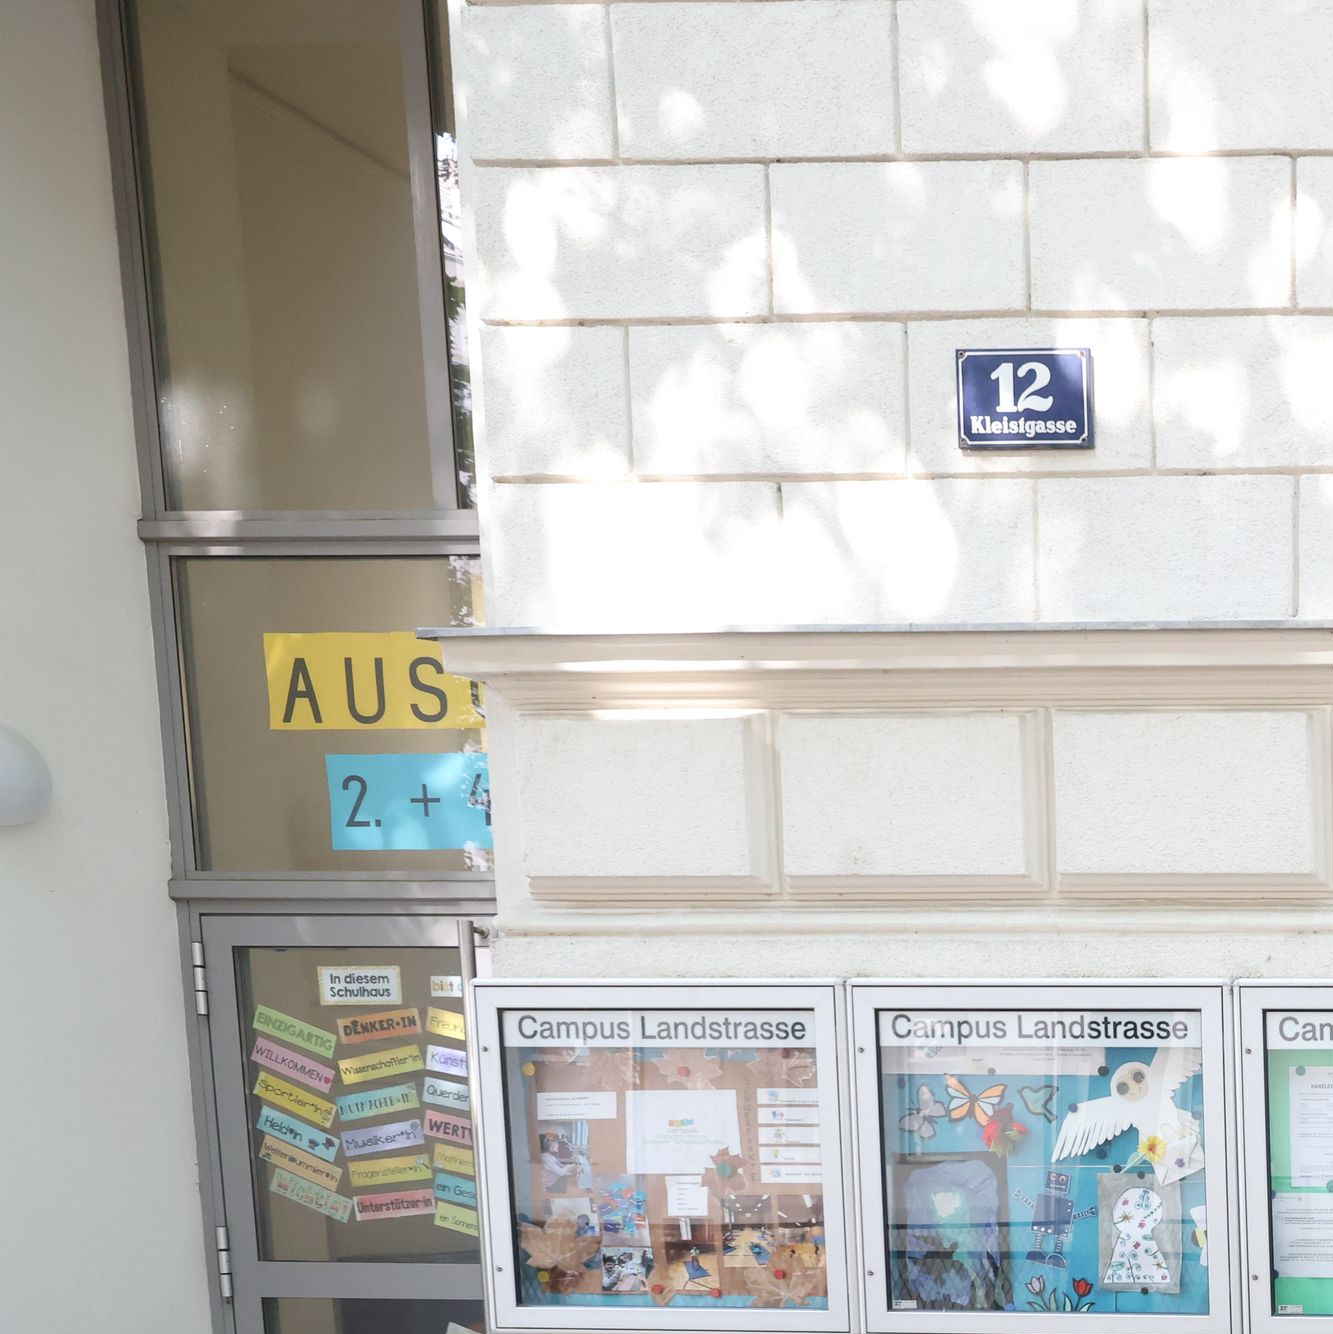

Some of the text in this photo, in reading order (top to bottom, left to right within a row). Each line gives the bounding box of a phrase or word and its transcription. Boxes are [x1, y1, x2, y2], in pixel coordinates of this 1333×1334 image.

[990, 362, 1053, 412] 12
[970, 416, 1077, 437] Kleistgasse
[341, 775, 381, 827] 2.
[410, 783, 441, 817] +
[330, 973, 390, 984] In diesem
[330, 987, 391, 998] Schulhaus
[257, 1012, 332, 1051] EINZIGARTIG
[518, 1014, 806, 1045] Campus Landstrasse
[891, 1014, 1189, 1045] Campus Landstrasse
[256, 1045, 324, 1082] WILLKOMMEN
[436, 1183, 450, 1193] ein
